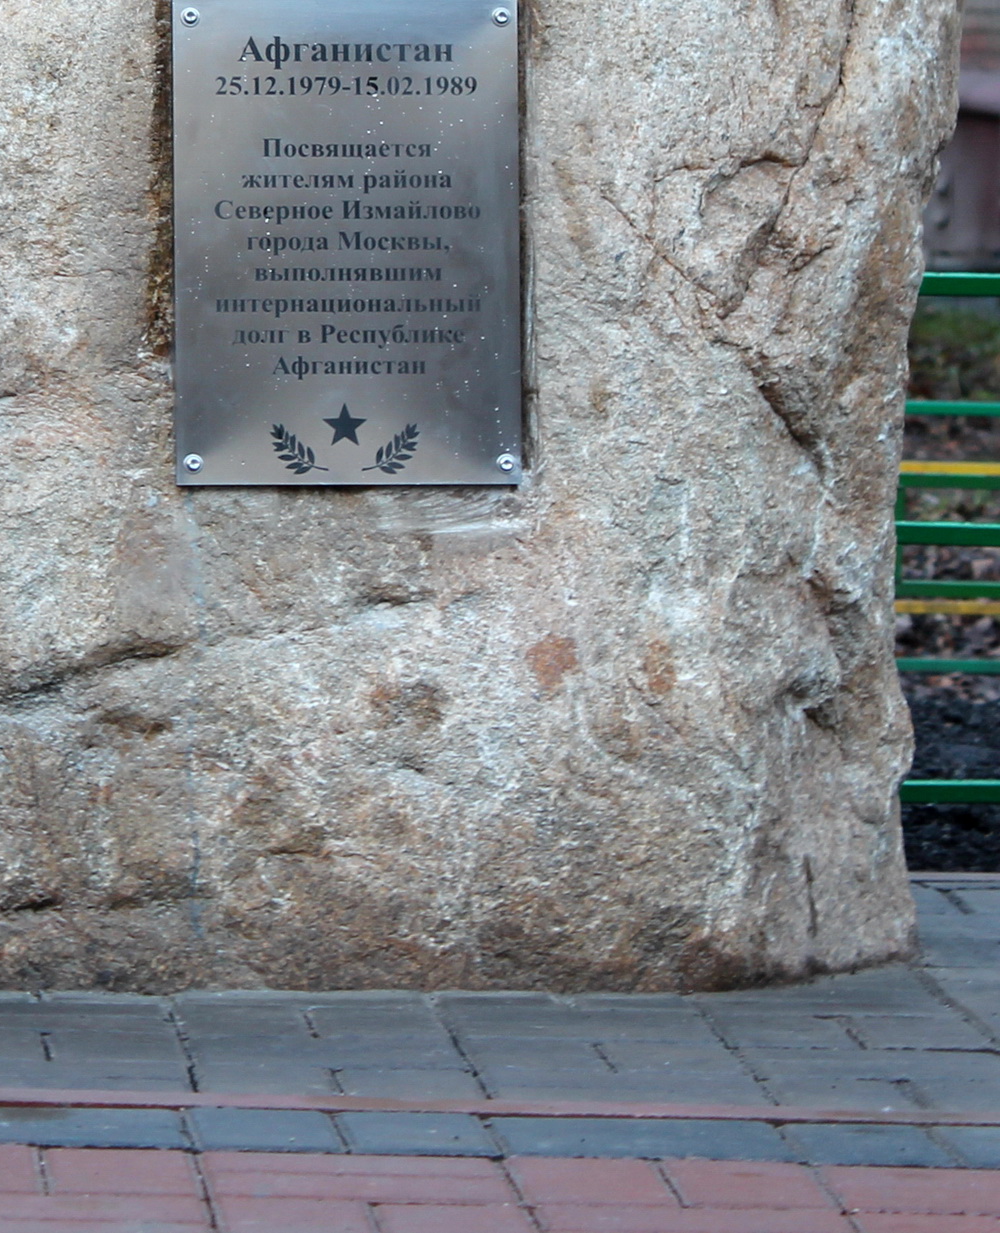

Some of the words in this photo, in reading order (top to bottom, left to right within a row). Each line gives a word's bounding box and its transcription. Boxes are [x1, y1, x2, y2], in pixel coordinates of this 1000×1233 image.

[238, 35, 454, 69] Афганистан
[215, 75, 478, 97] 25.12.1979-15.02.1989
[262, 137, 432, 160] Посвящается
[241, 171, 355, 190] жителям
[363, 168, 453, 194] района
[214, 199, 334, 226] Северное
[342, 198, 481, 221] Измайлово
[246, 233, 329, 257] города
[338, 231, 451, 254] Москвы,
[254, 265, 443, 283] выполнявшим
[215, 292, 482, 319] интернациональный
[232, 327, 290, 346] долг
[298, 328, 312, 344] в
[320, 323, 464, 349] Республике
[272, 355, 427, 380] Афганистан
